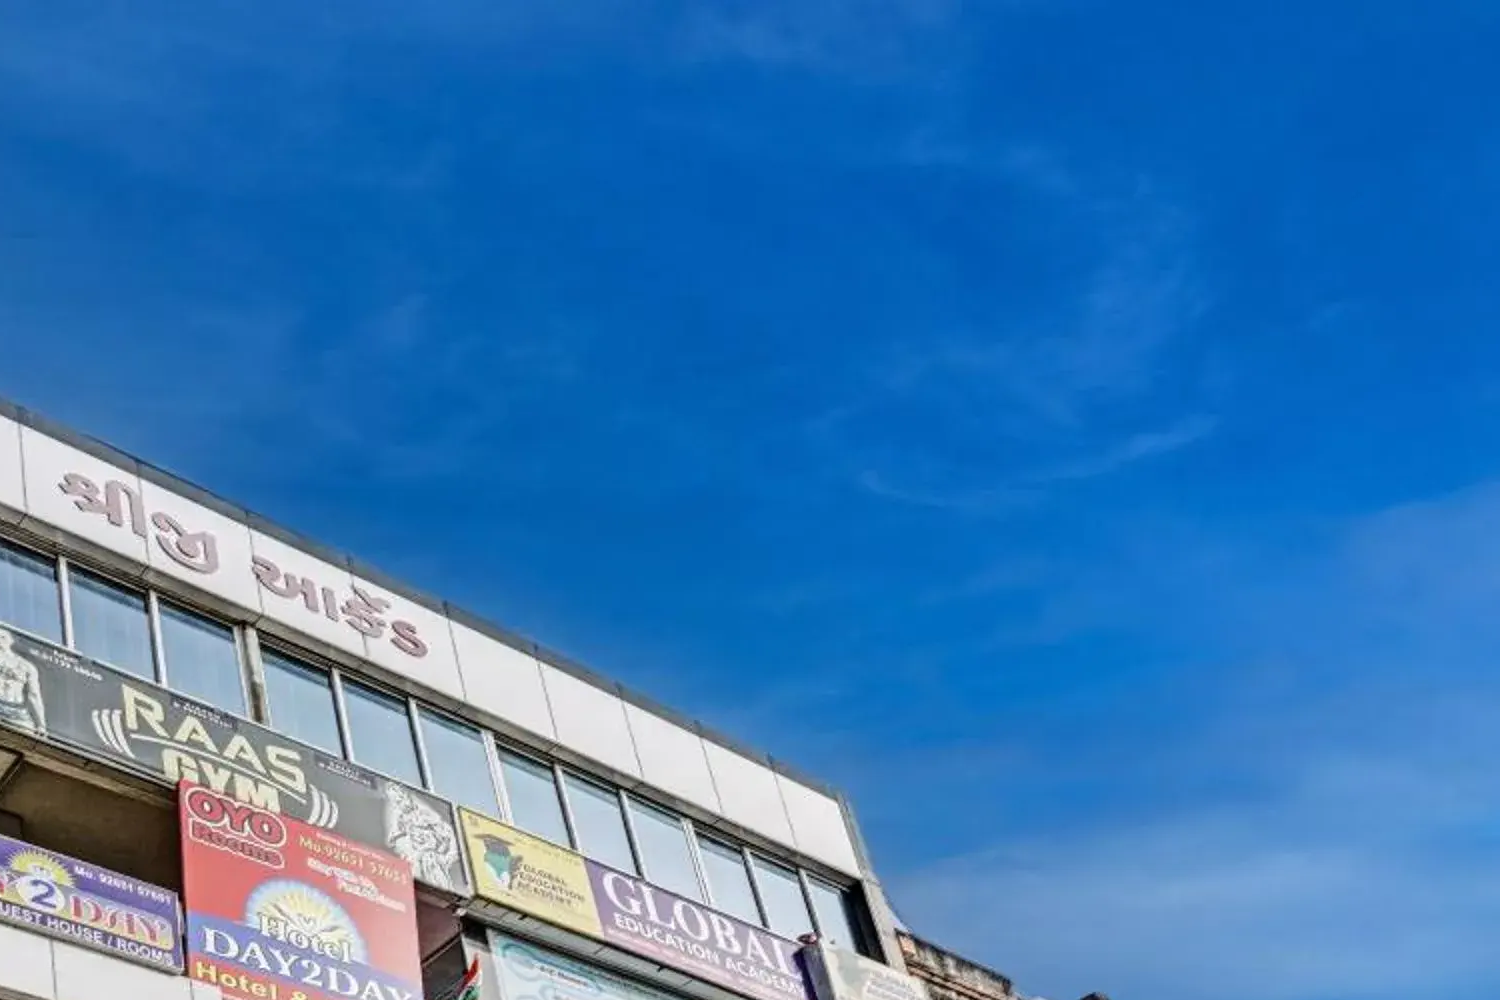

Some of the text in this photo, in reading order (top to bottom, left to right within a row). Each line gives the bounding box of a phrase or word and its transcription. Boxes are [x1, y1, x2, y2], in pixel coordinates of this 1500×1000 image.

[121, 683, 308, 793] RAAS
[160, 748, 282, 812] GYM
[187, 788, 286, 848] OYO
[30, 878, 58, 910] 2
[71, 894, 173, 946] DAY
[47, 915, 103, 943] HOUSE
[117, 940, 175, 966] ROOMS
[258, 914, 351, 963] Hotel
[602, 872, 800, 977] GLOBAL
[614, 912, 721, 969] EDUCATION
[196, 961, 278, 1000] Hotel
